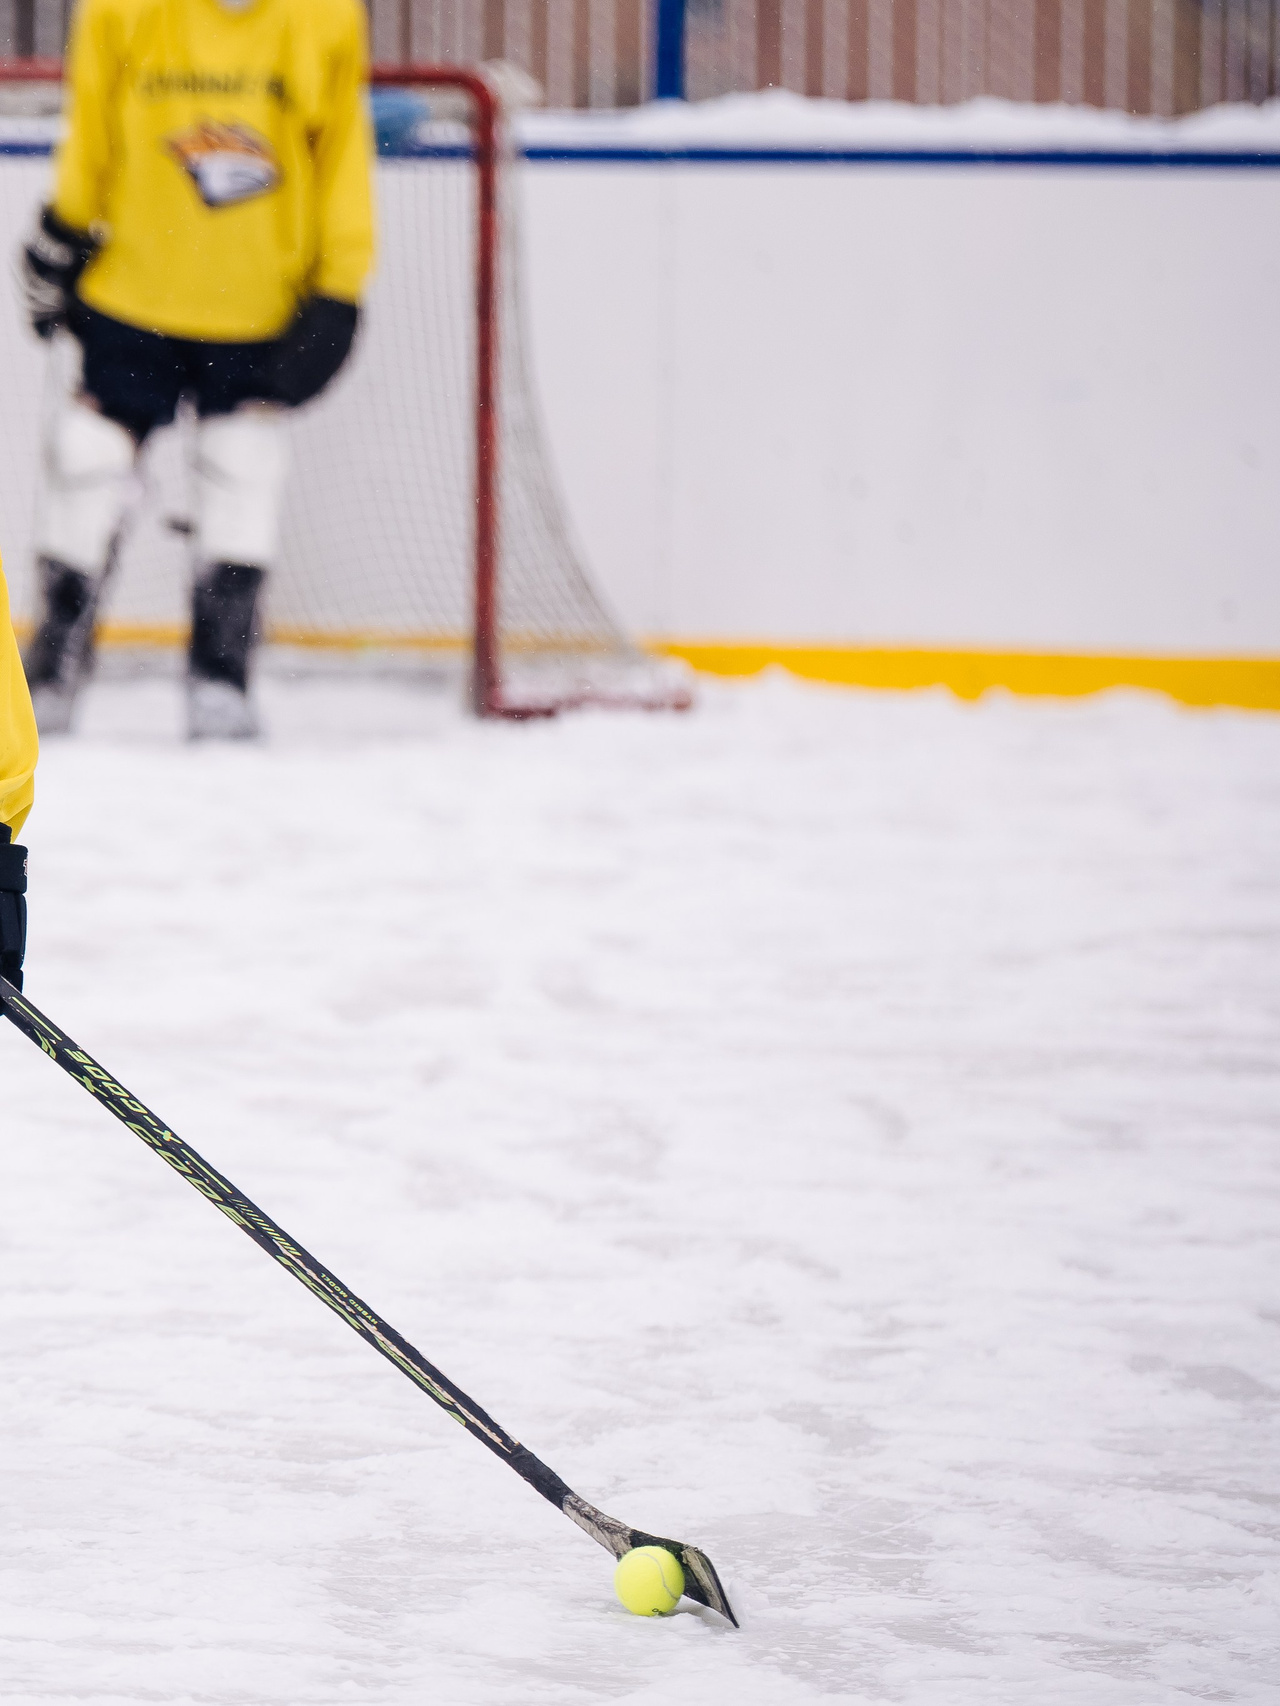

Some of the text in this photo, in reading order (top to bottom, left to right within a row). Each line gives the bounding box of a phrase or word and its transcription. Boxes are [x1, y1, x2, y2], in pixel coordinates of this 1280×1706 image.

[63, 1047, 183, 1144] X-CODE
[69, 1070, 256, 1230] X-CODE
[320, 1272, 379, 1325] HYBRID MODEL
